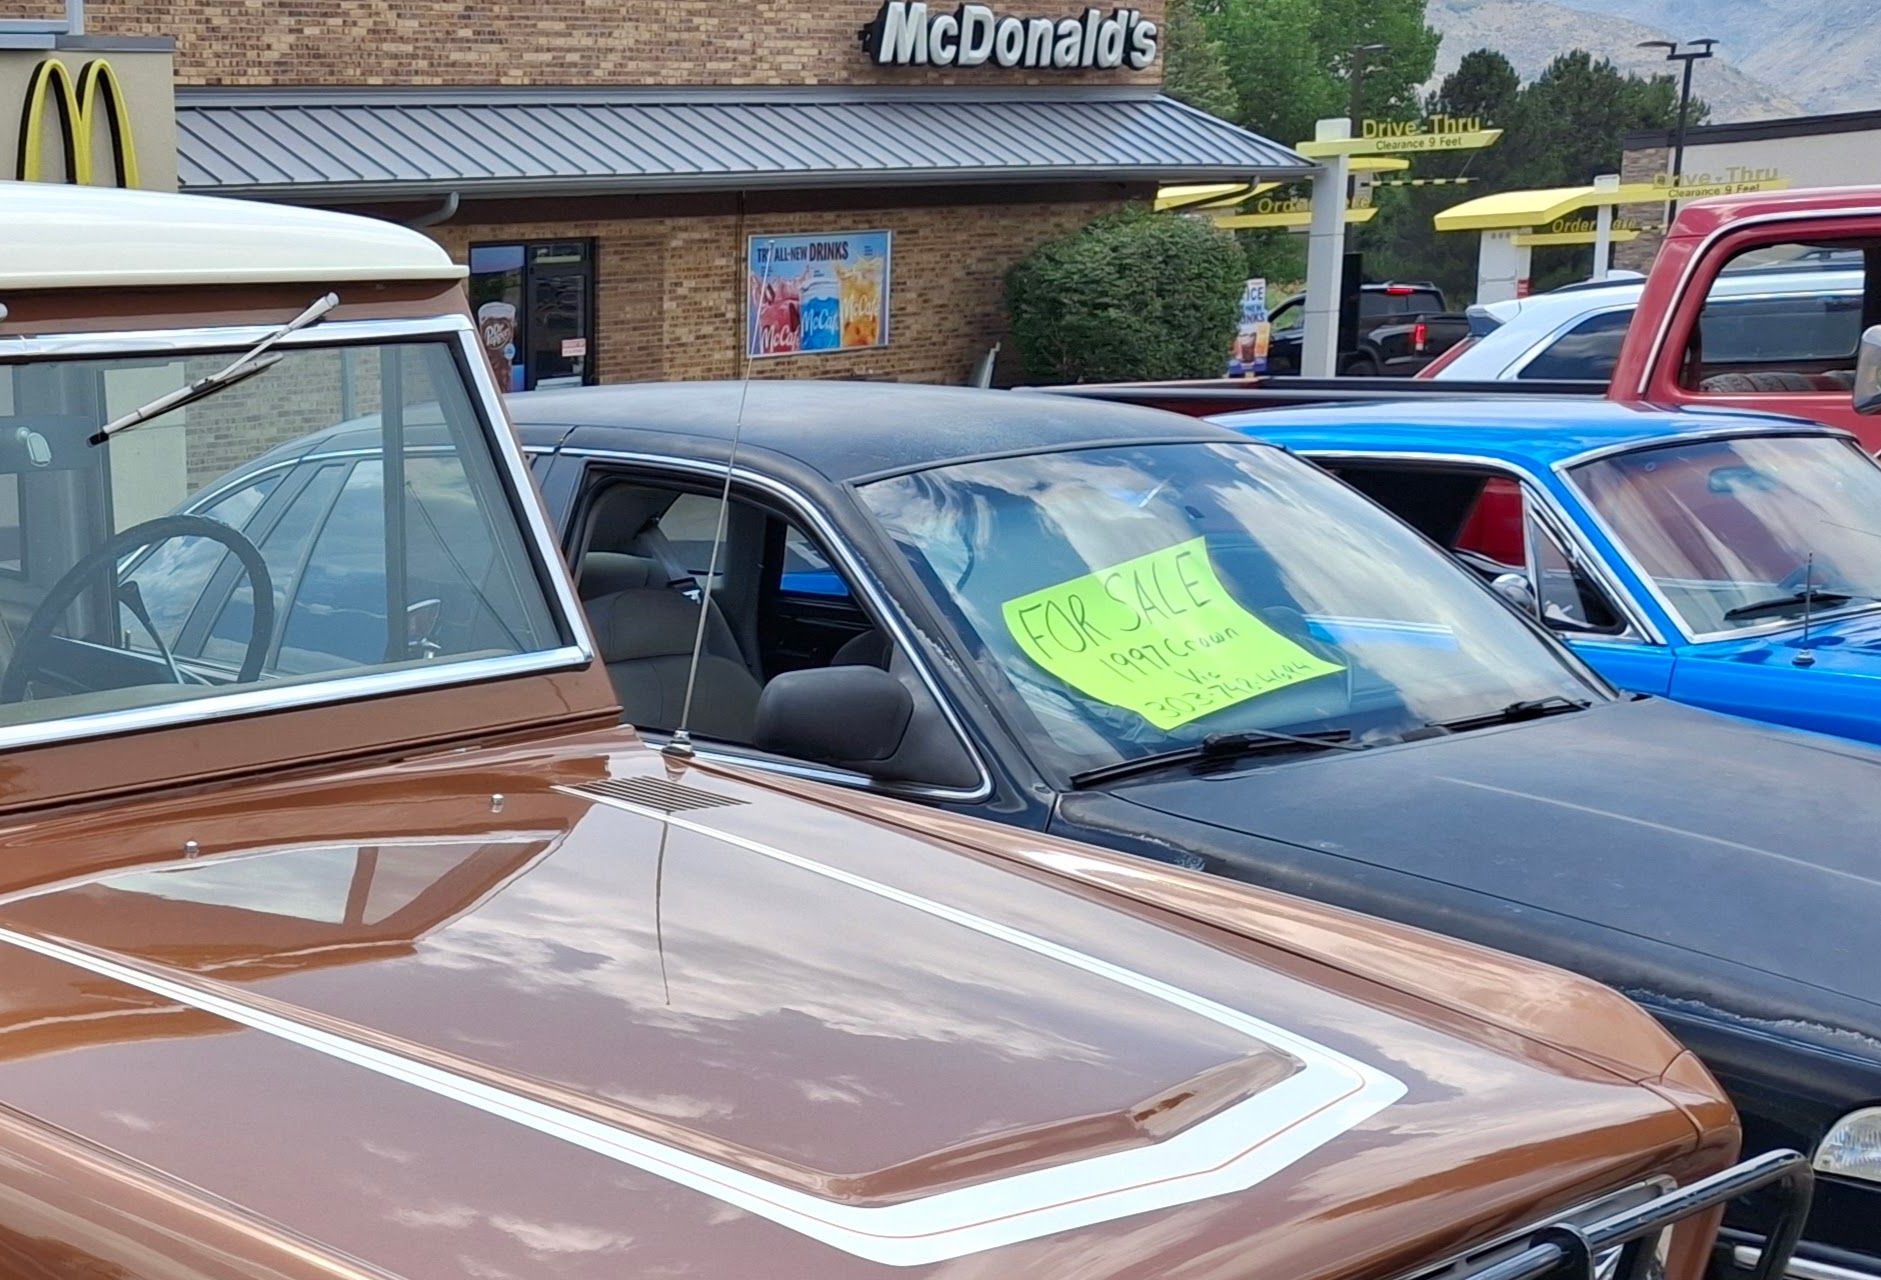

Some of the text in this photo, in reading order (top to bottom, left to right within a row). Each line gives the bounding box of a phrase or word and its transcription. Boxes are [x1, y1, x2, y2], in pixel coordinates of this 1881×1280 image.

[879, 1, 1157, 69] McDonald's
[1362, 114, 1480, 139] Drive-Thru
[1376, 136, 1462, 151] Clearance 9 Feet
[1667, 183, 1760, 199] Clearance 9 Feet
[1257, 196, 1312, 214] Orde
[775, 245, 807, 262] ALL-NEW
[809, 241, 849, 261] DRINKS
[1018, 551, 1212, 660] FOR SALE
[1099, 627, 1240, 683] 1997 Crown
[1174, 668, 1221, 684] Vic
